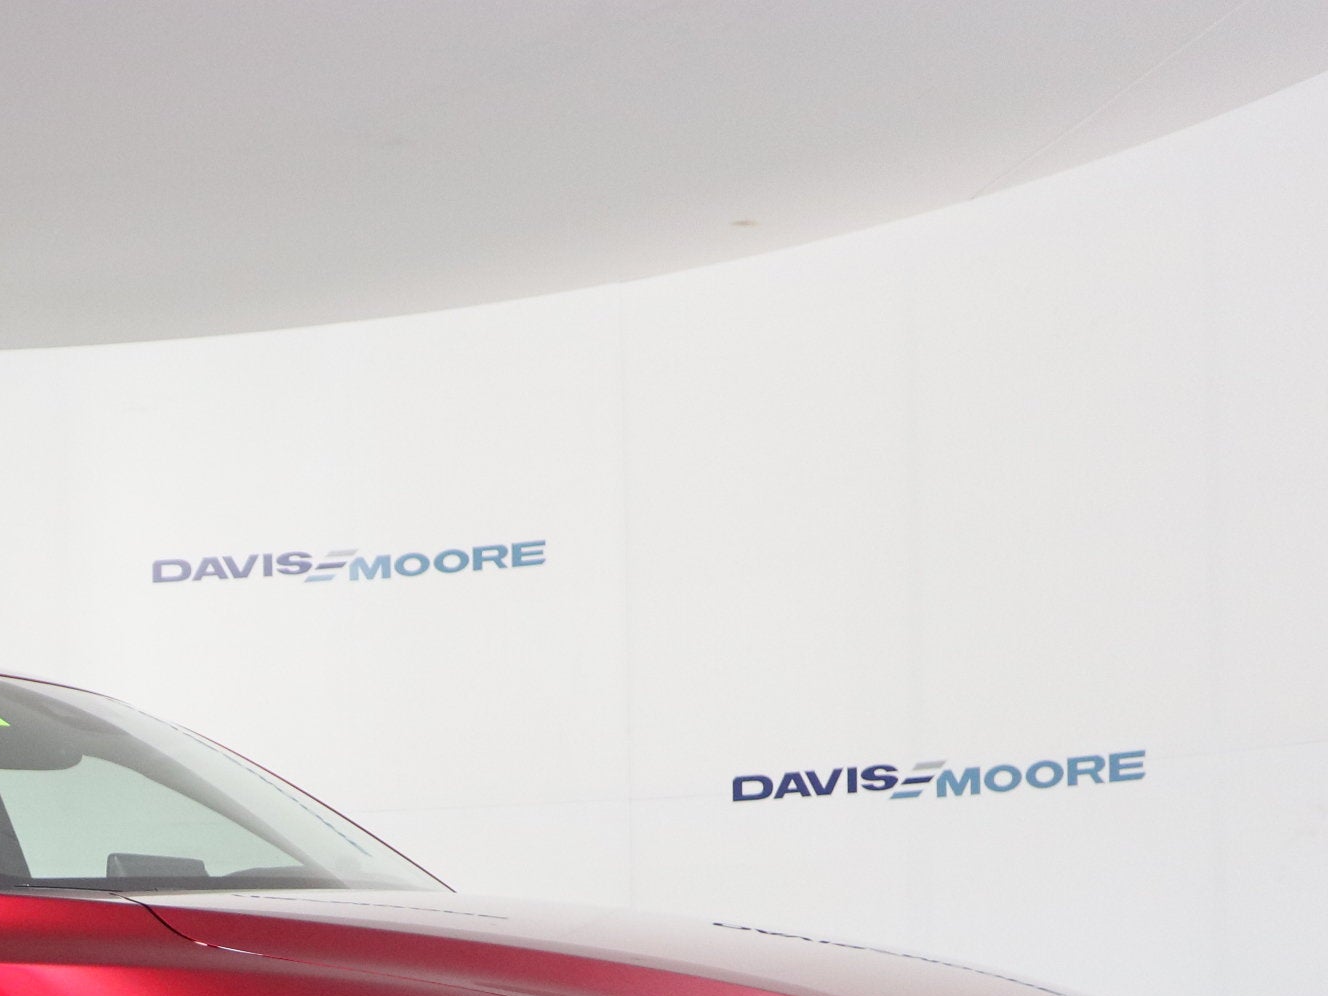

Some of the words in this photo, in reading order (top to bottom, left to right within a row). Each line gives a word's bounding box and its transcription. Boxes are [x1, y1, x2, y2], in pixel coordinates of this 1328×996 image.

[152, 550, 313, 584] DAVIS
[348, 539, 547, 582] MOORE
[732, 763, 899, 802] DAVIS
[936, 749, 1147, 799] MOORE
